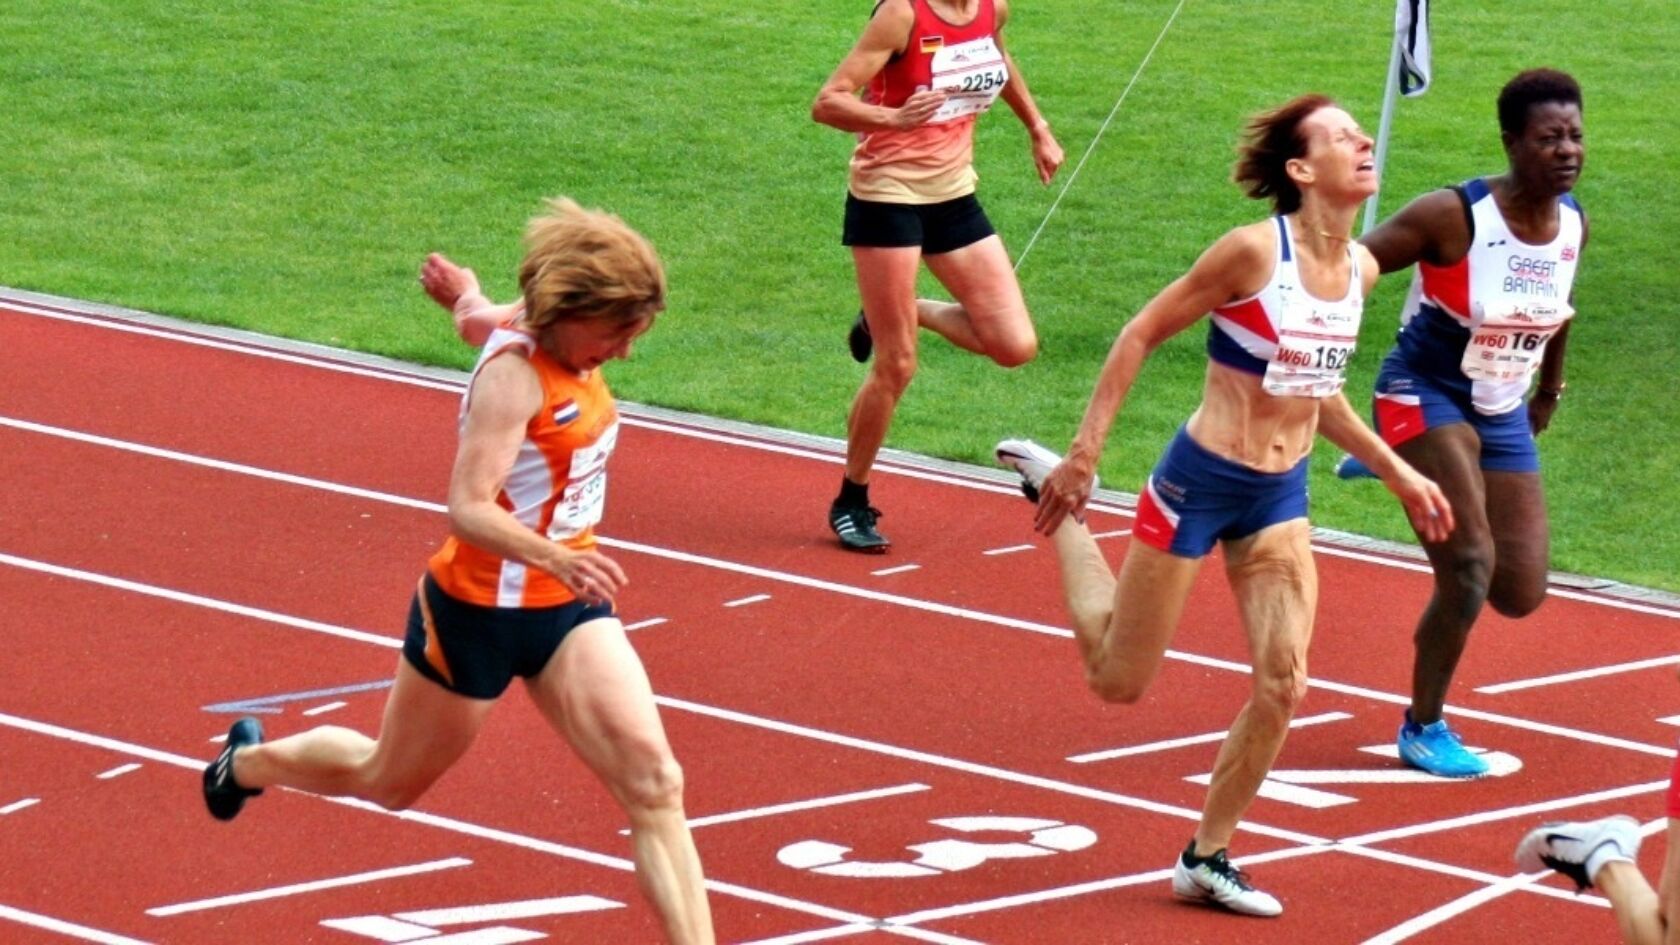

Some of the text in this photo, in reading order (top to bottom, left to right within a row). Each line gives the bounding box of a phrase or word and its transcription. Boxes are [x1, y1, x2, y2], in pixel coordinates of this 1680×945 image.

[961, 69, 1004, 93] 2254
[1507, 254, 1557, 278] GREAT
[1503, 275, 1558, 298] BRITAIN
[1473, 334, 1508, 349] W60
[1277, 347, 1311, 367] W60
